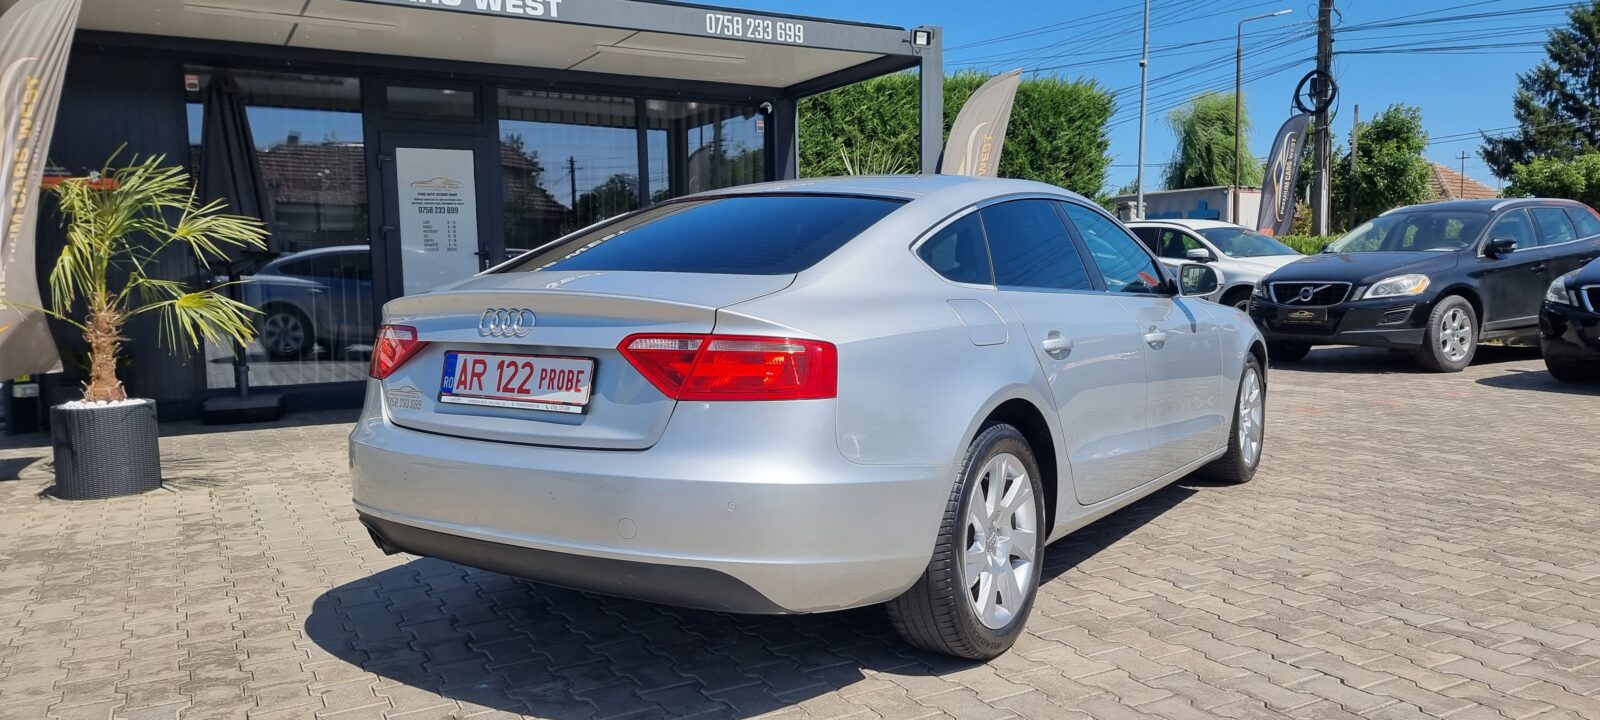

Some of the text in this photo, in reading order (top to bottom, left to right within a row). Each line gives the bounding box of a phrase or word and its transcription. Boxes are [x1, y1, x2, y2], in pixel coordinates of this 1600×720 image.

[475, 0, 562, 17] WEST
[705, 13, 804, 43] 0758 233 699
[18, 75, 39, 139] WEST
[10, 147, 29, 208] CARS
[1285, 160, 1293, 181] CARS
[418, 206, 433, 214] 0758
[443, 376, 454, 389] RO
[456, 358, 585, 395] AR 122 PROBE
